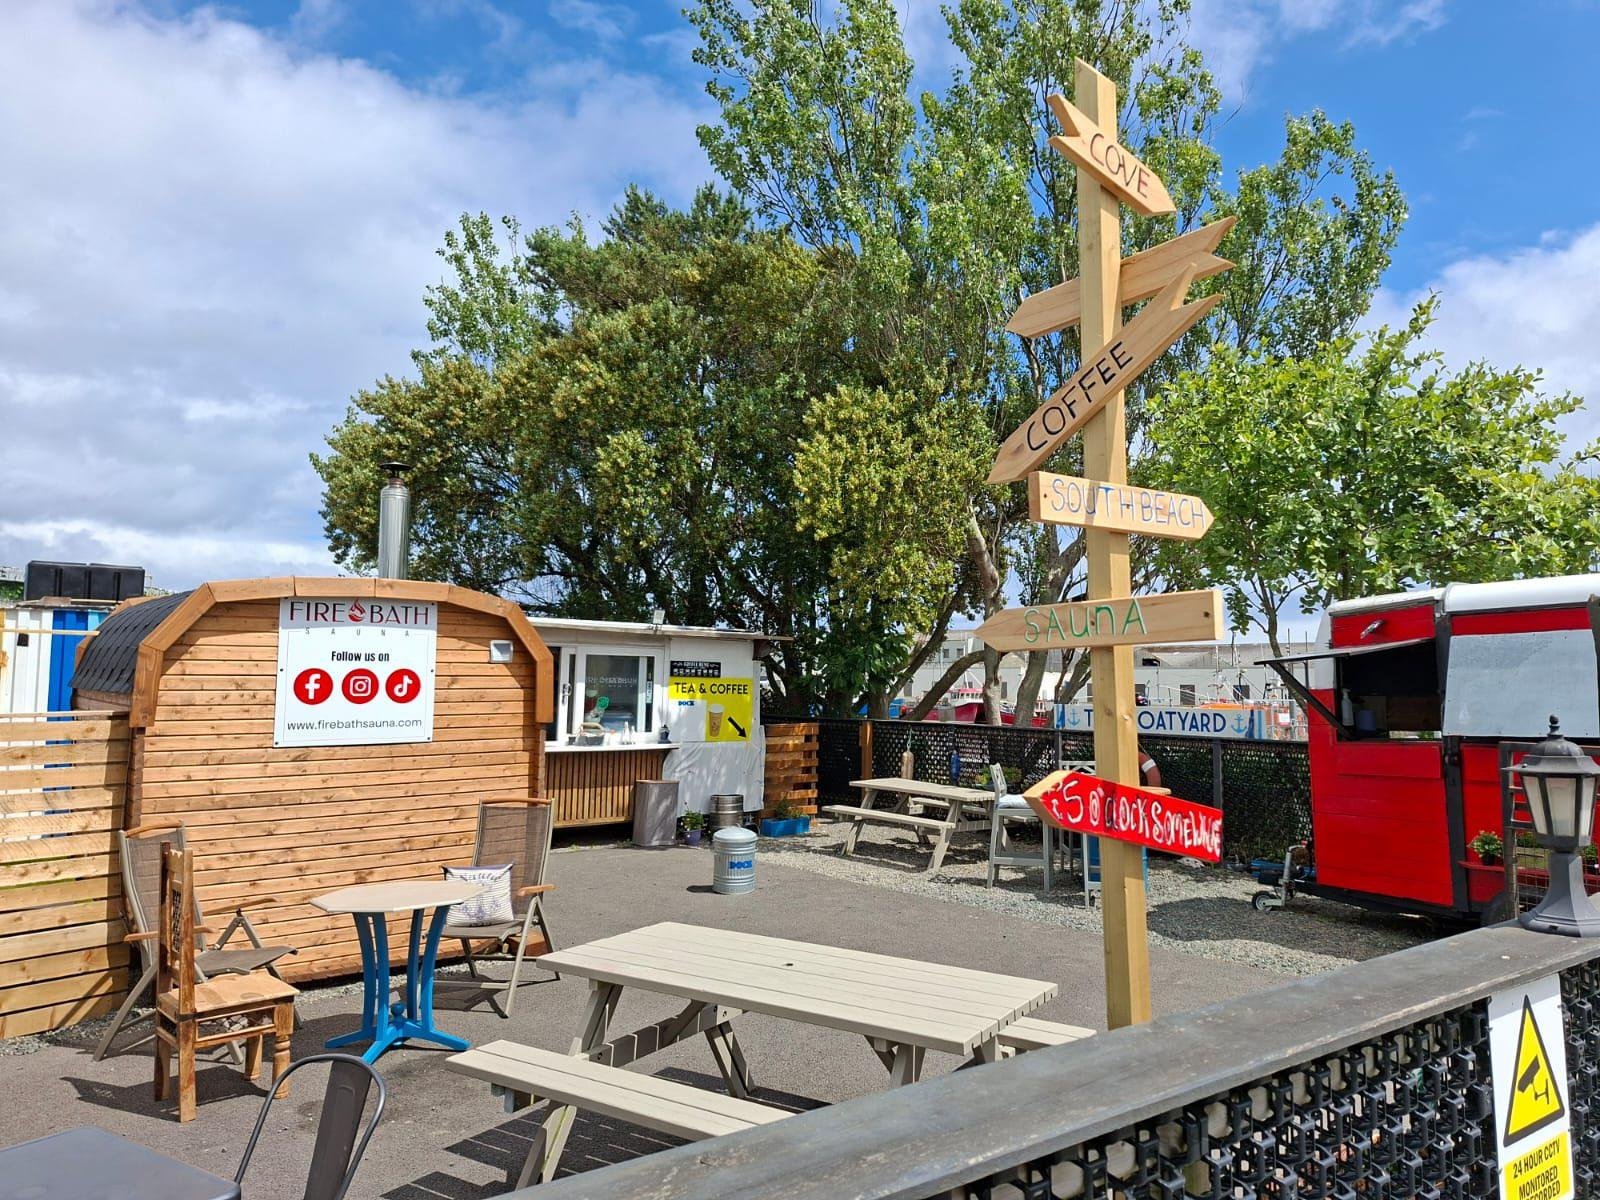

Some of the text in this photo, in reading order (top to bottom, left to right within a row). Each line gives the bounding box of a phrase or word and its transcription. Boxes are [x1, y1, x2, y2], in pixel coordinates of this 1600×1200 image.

[1089, 133, 1150, 199] COVE
[1027, 341, 1134, 451] COFFEE
[289, 601, 429, 625] FIRE BATH
[331, 651, 390, 662] Follow us on
[674, 682, 748, 694] TEA & COFFEE
[287, 719, 422, 731] www.firebathsauna.com
[1138, 710, 1226, 733] OATYARD
[1513, 1138, 1560, 1179] 24 HOUR CCTV
[1519, 1165, 1558, 1200] MONITORED
